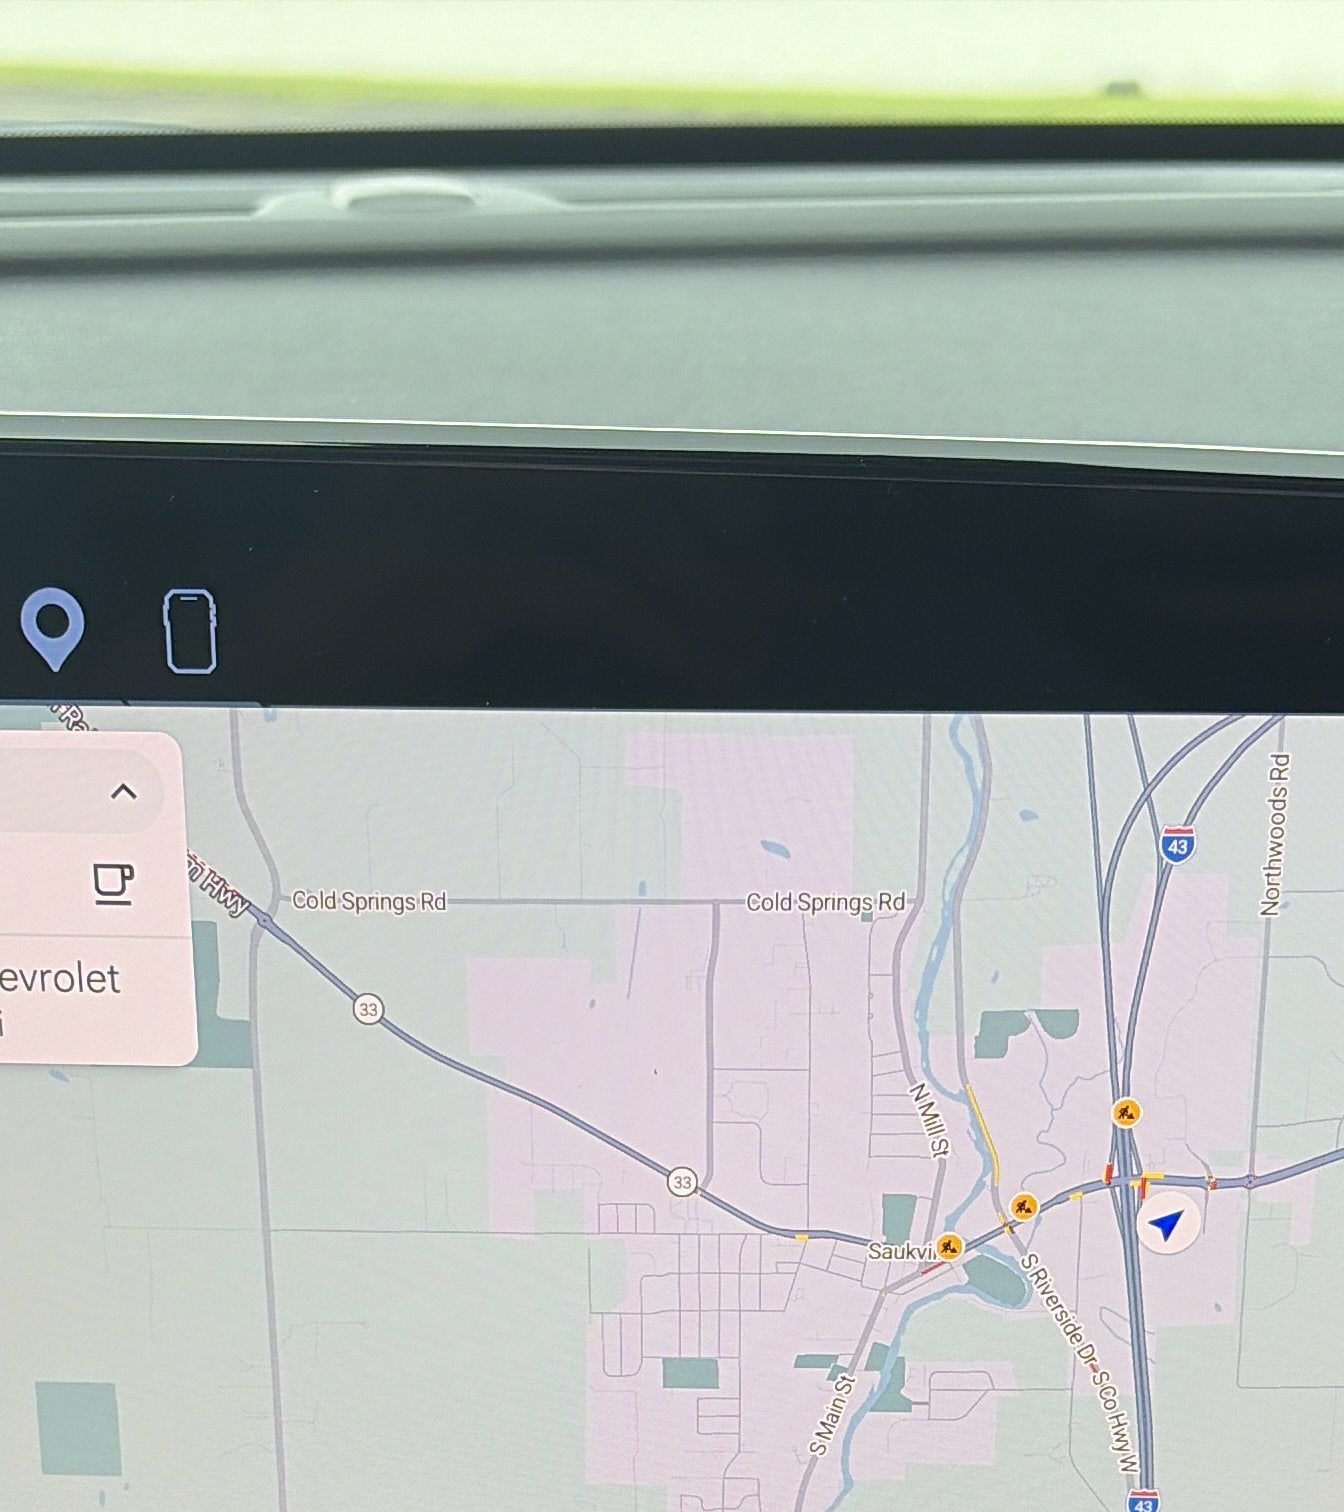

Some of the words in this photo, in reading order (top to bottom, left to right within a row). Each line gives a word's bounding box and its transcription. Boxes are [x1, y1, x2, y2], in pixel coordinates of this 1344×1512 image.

[1270, 754, 1290, 781] Rd
[1168, 839, 1188, 854] 43
[1261, 787, 1288, 916] Northwoods
[199, 868, 252, 918] Hwy
[293, 890, 338, 910] Cold
[342, 890, 416, 915] Springs
[421, 890, 446, 911] Rd
[746, 892, 792, 912] Cold
[798, 892, 873, 917] Springs
[879, 892, 905, 912] Rd
[360, 1003, 378, 1016] 33
[909, 1083, 931, 1102] N
[918, 1101, 946, 1136] Mill
[931, 1138, 949, 1158] St
[674, 1176, 691, 1189] 33
[868, 1242, 938, 1260] Saukvi
[1021, 1253, 1039, 1269] S
[1029, 1267, 1083, 1345] Riverside
[1077, 1343, 1098, 1364] Dr
[834, 1375, 856, 1395] St
[1092, 1371, 1110, 1386] S
[1099, 1385, 1117, 1411] Co
[815, 1397, 846, 1441] Main
[1108, 1412, 1130, 1452] Hwy
[809, 1441, 827, 1456] S
[1119, 1454, 1138, 1473] W
